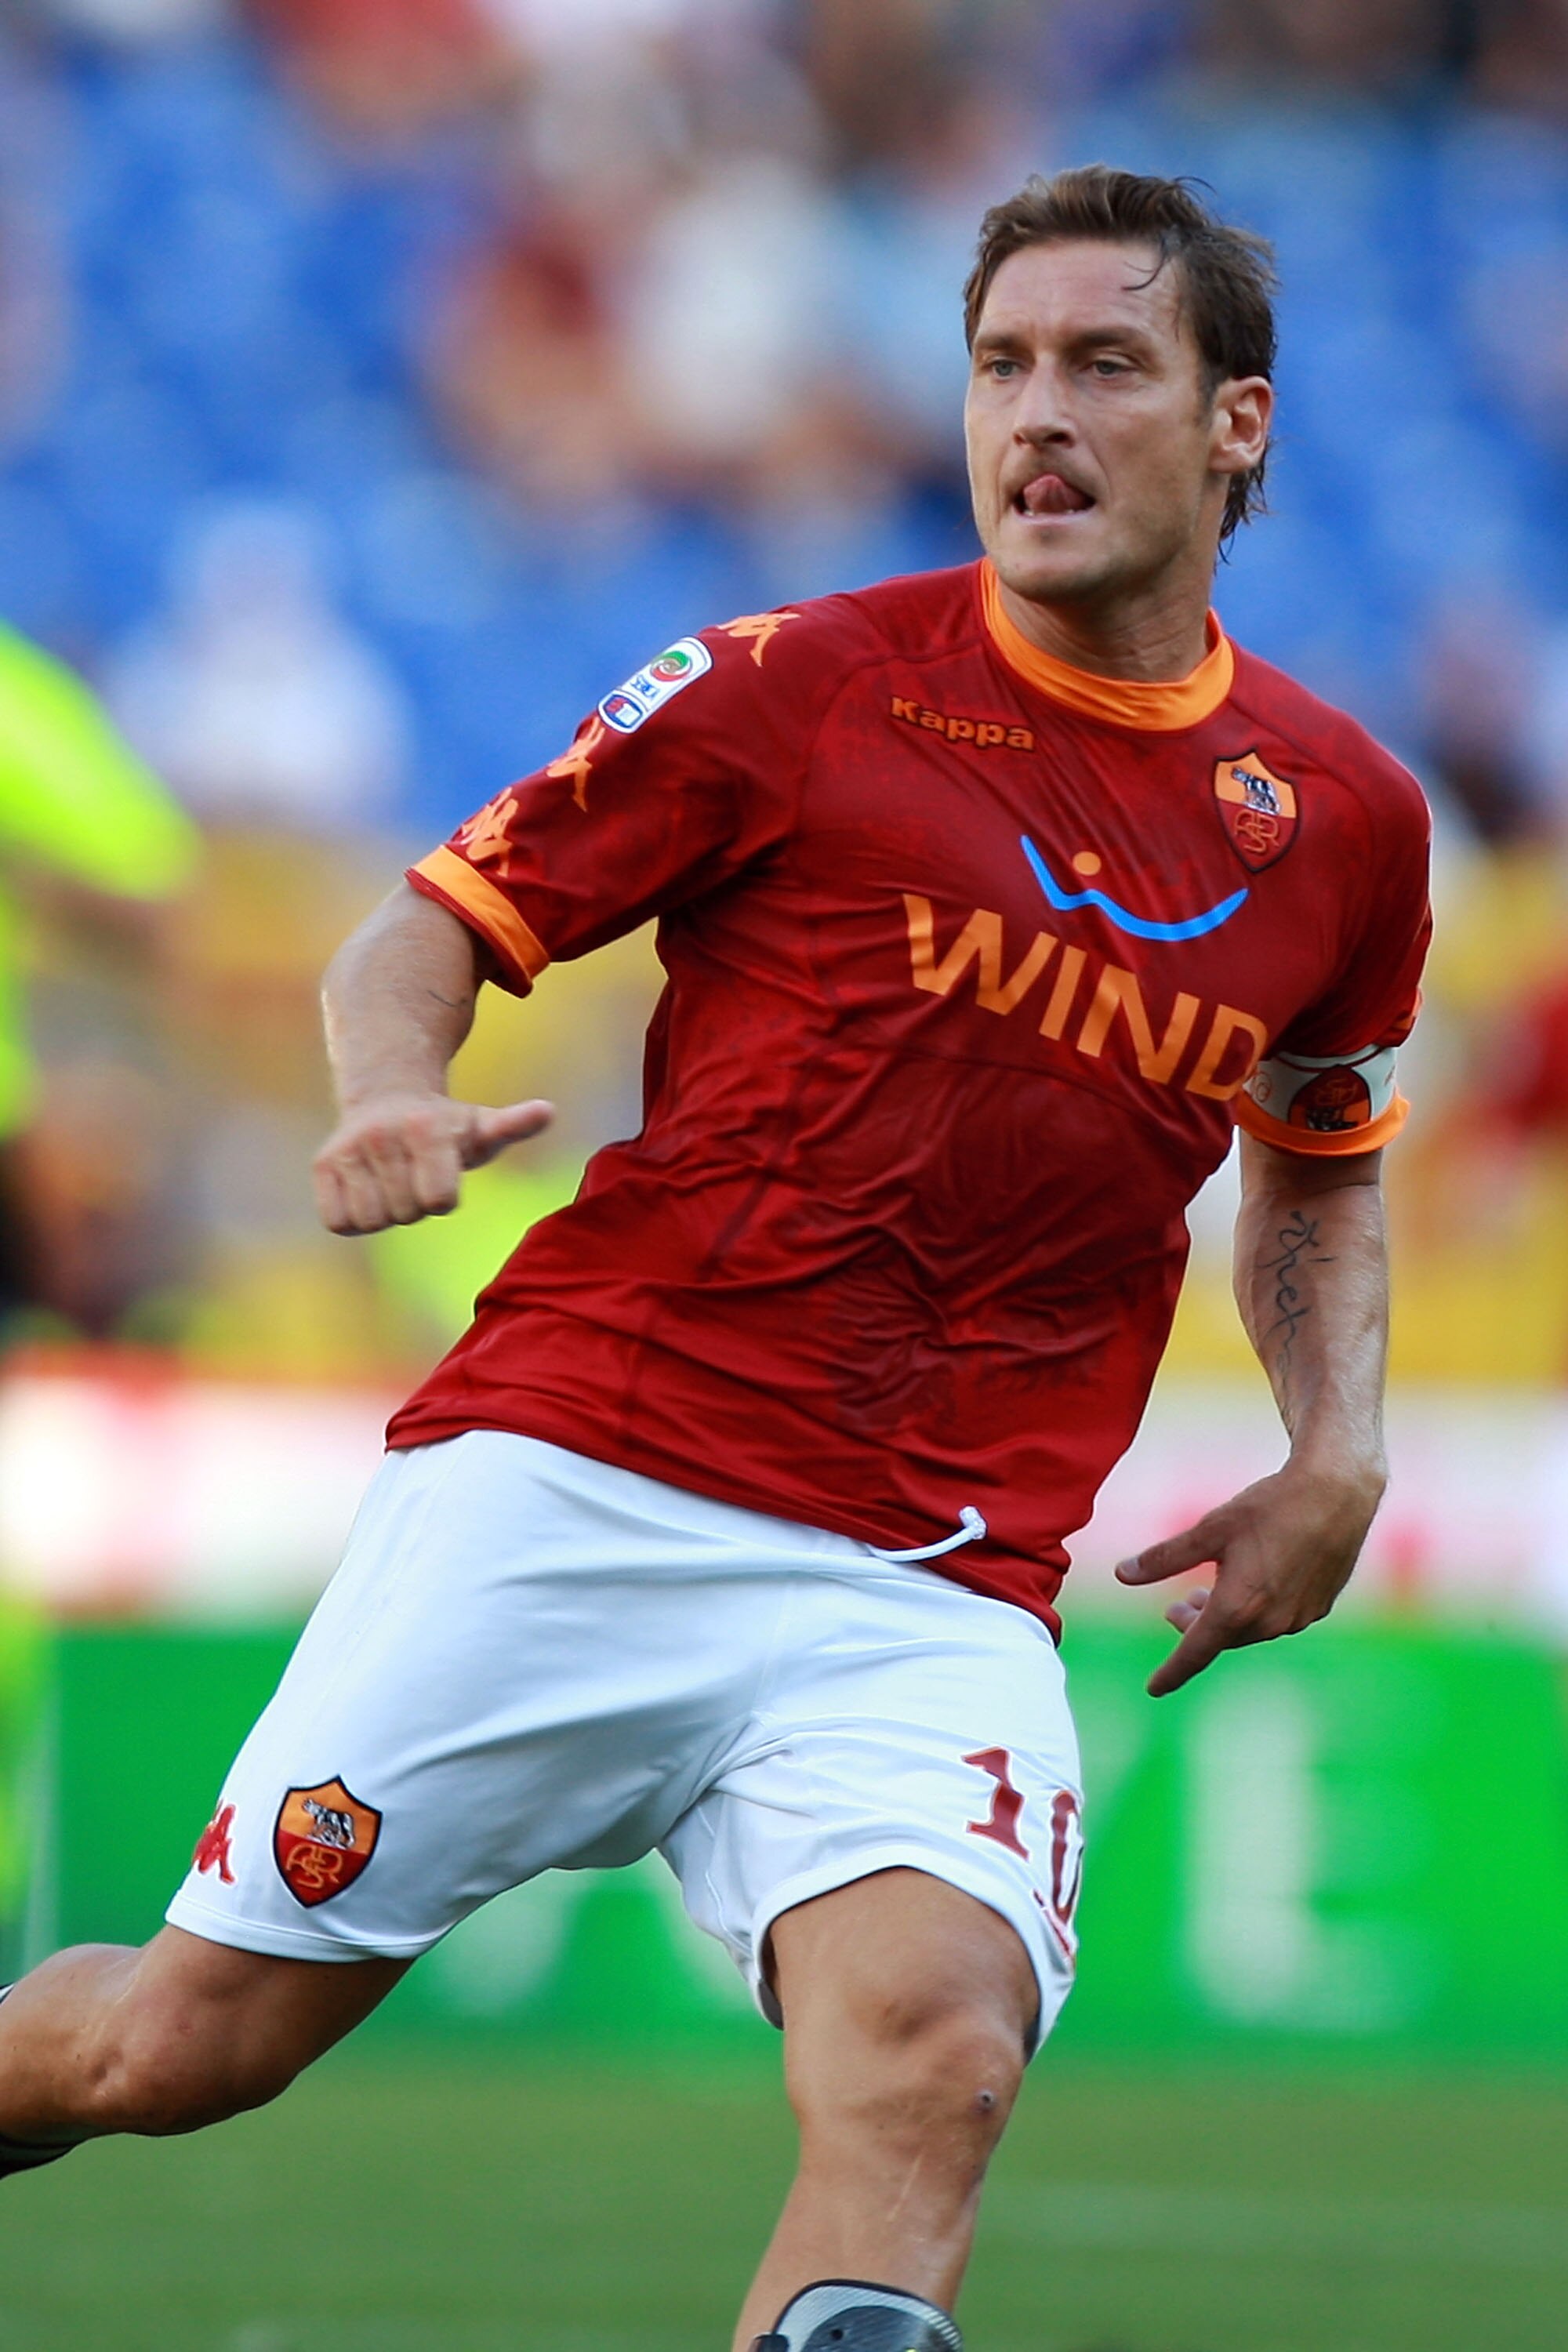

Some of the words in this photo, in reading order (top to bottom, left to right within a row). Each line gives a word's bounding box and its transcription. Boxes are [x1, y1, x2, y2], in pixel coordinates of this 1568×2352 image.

[891, 696, 1035, 750] Kappa
[902, 893, 1269, 1102] WIND
[961, 1745, 1084, 1926] 10
